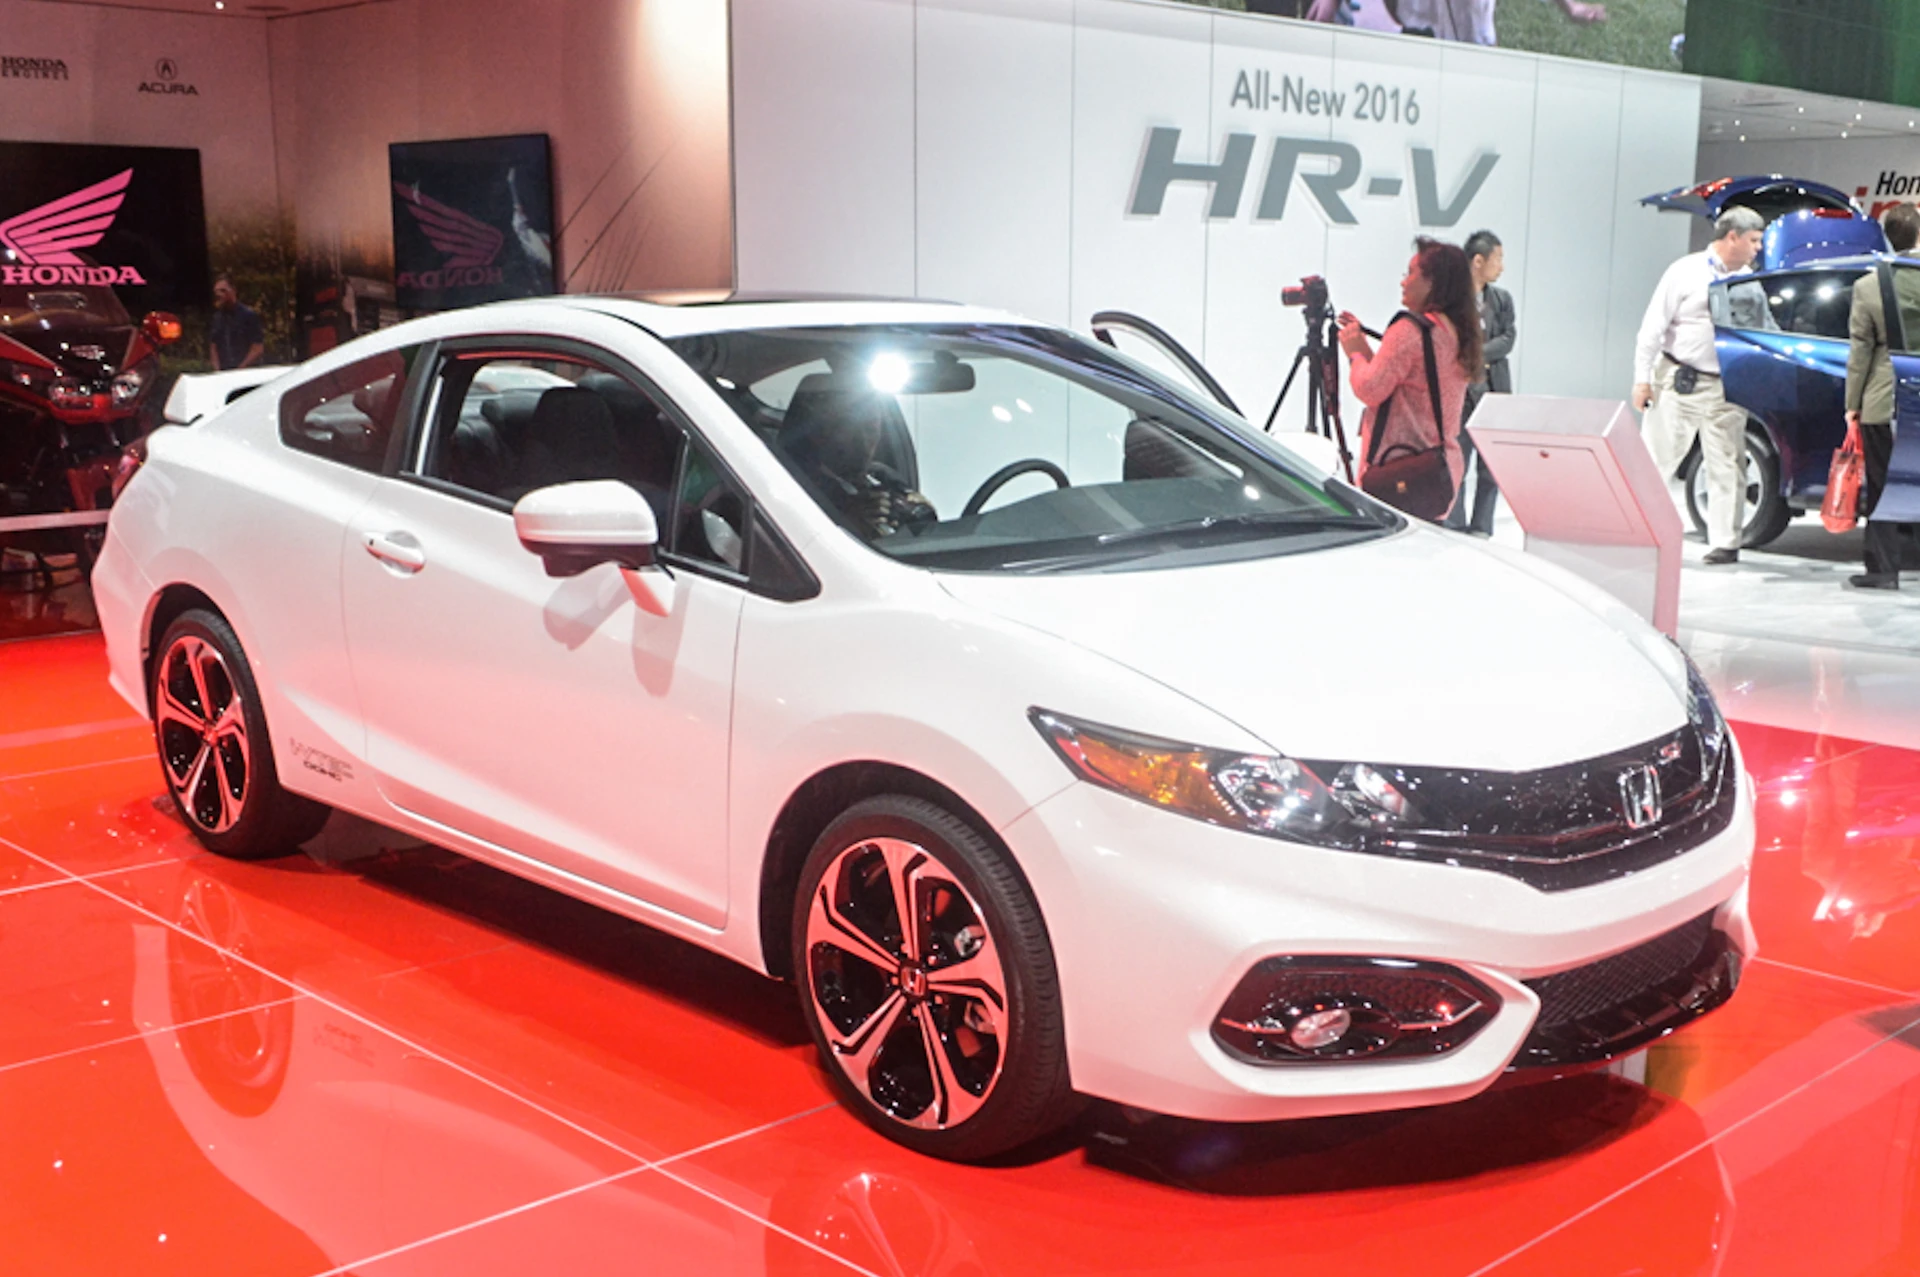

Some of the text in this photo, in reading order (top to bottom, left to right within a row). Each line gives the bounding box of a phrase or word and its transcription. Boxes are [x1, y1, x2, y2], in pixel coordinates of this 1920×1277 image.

[1, 56, 67, 70] HONDA
[138, 81, 199, 96] ACURA
[1230, 69, 1421, 126] All-New 2016
[1128, 126, 1501, 227] HR-V
[2, 265, 147, 286] HONDA
